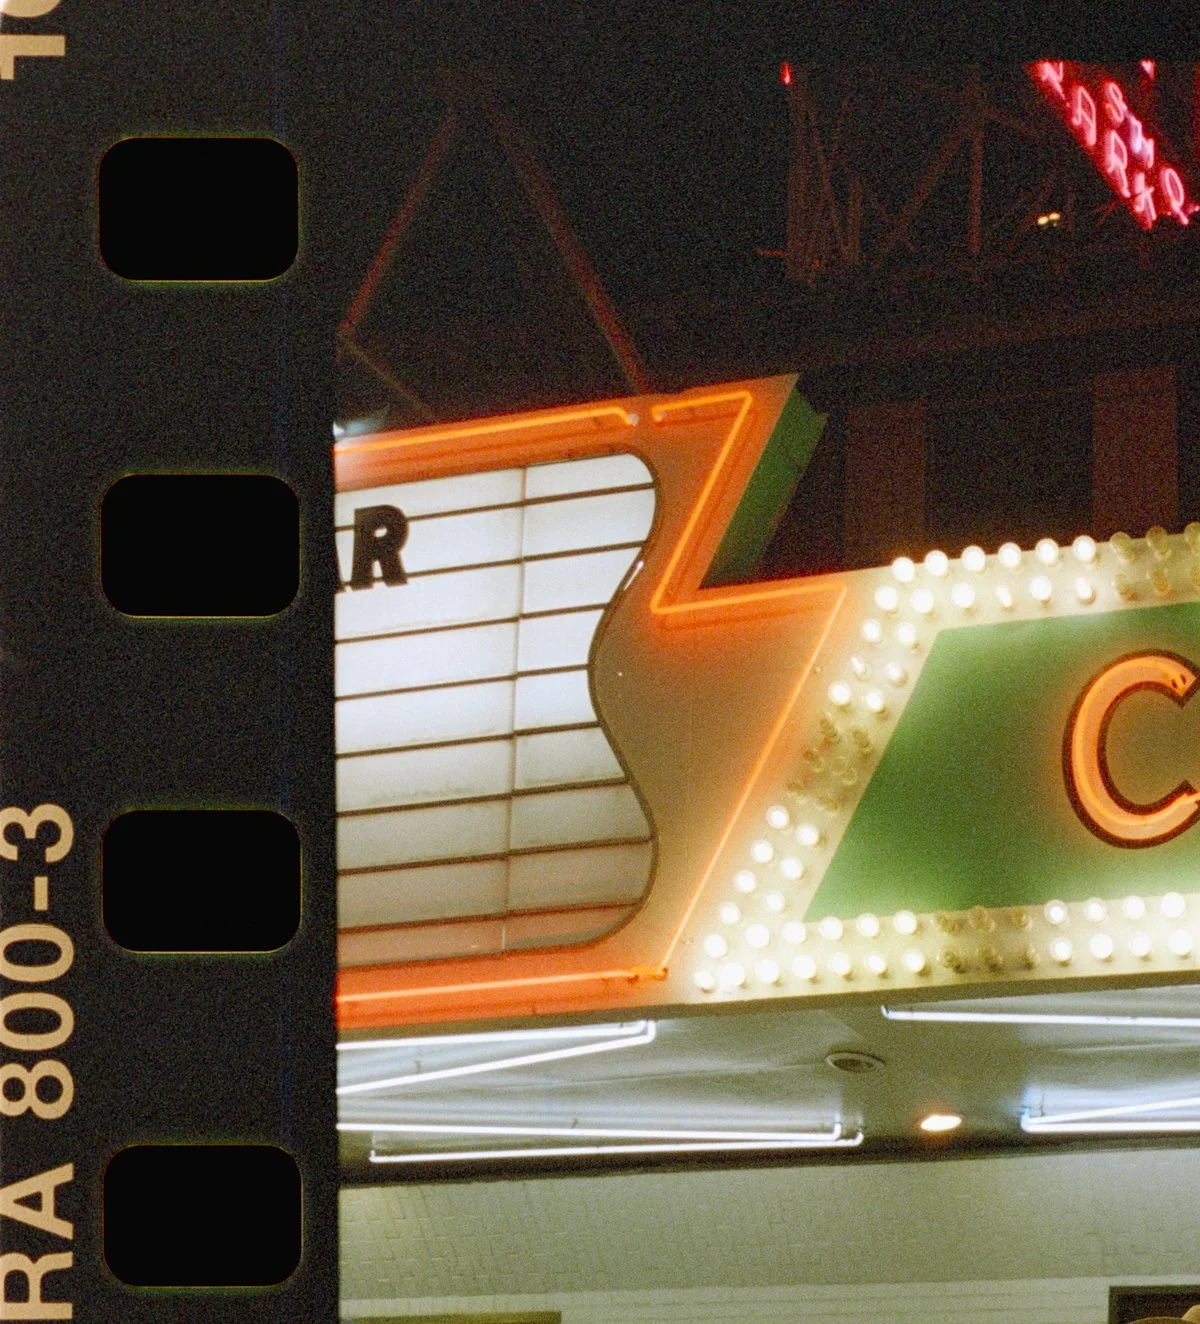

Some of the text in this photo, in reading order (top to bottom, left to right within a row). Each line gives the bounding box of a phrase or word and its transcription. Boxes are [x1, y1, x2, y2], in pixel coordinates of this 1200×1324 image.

[0, 0, 66, 80] 1
[334, 505, 409, 594] R
[0, 803, 74, 1120] 800-3
